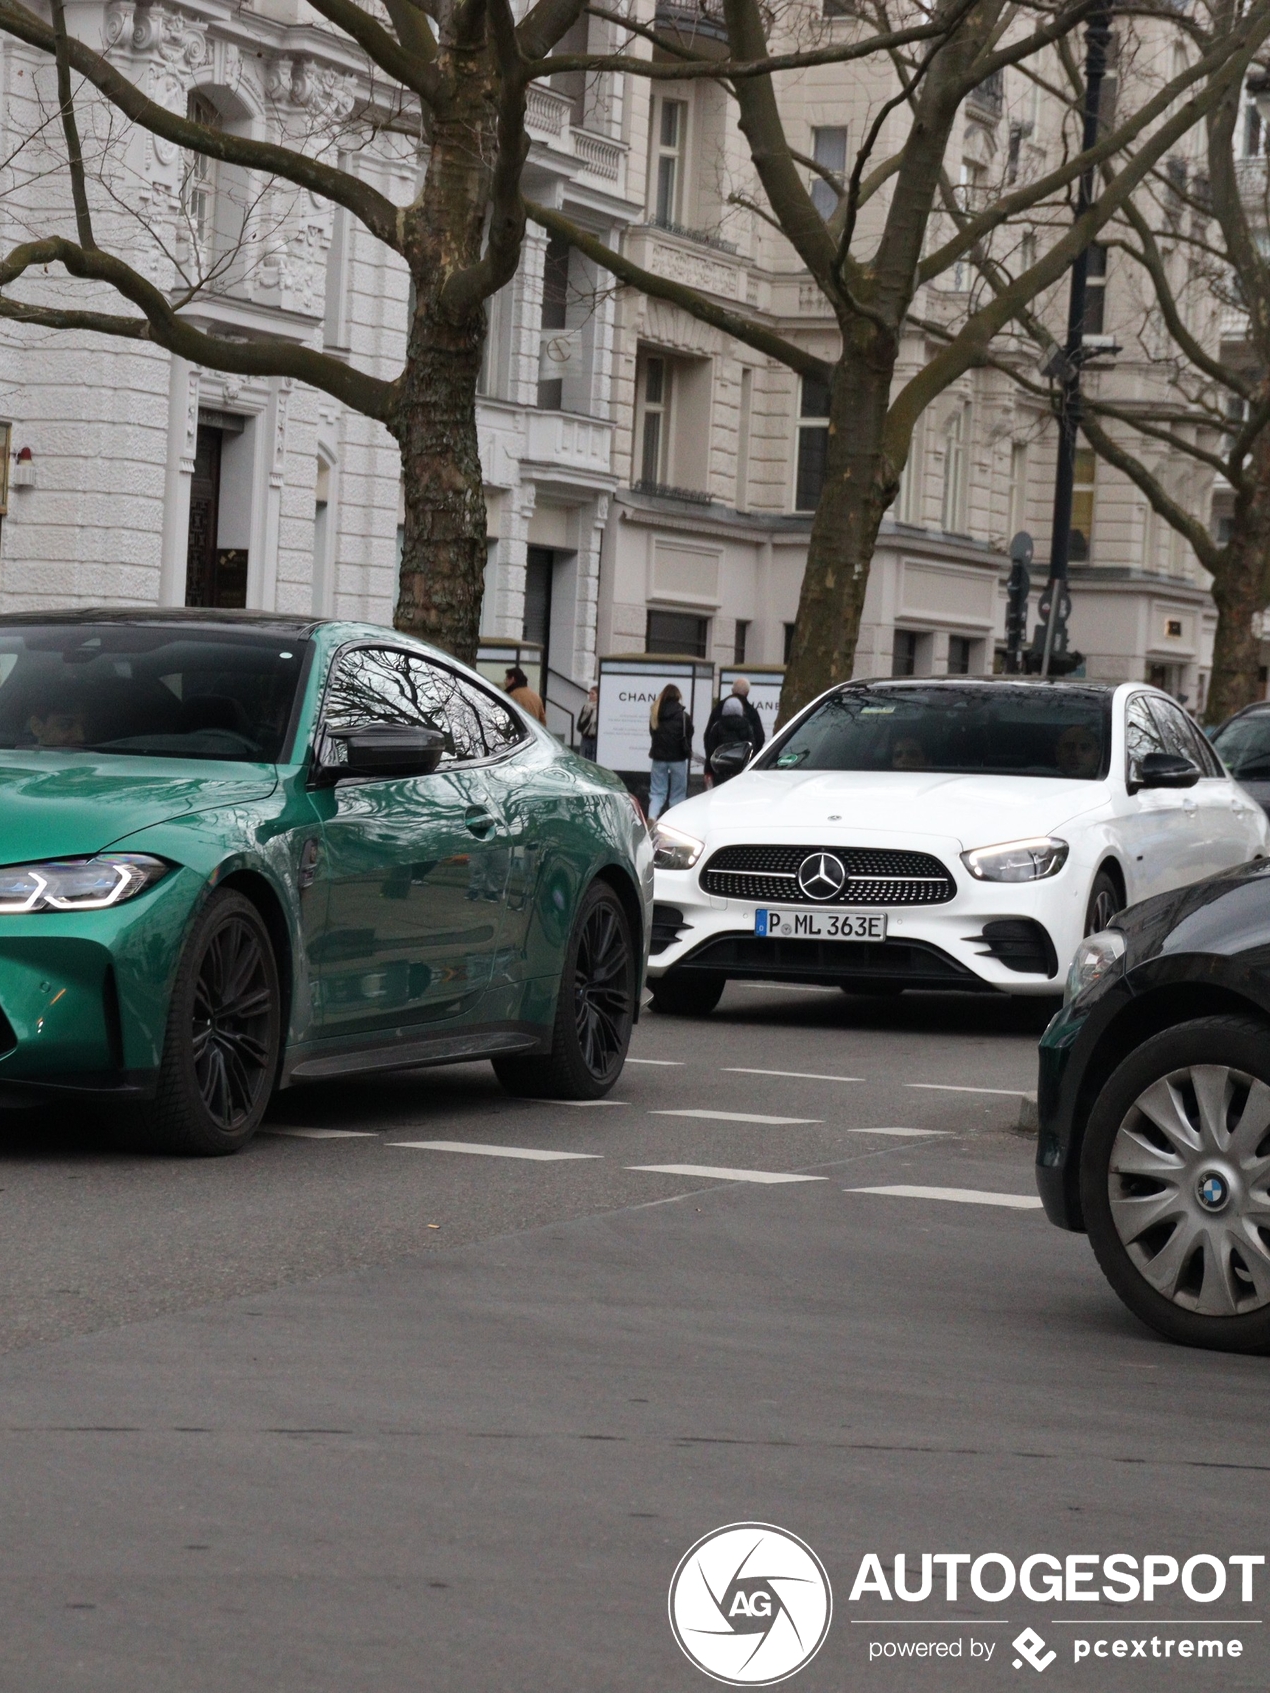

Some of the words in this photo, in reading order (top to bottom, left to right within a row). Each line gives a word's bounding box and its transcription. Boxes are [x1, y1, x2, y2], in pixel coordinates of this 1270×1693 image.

[618, 692, 656, 702] CHAN
[769, 913, 781, 932] P
[794, 914, 822, 935] ML
[826, 915, 881, 937] 363E
